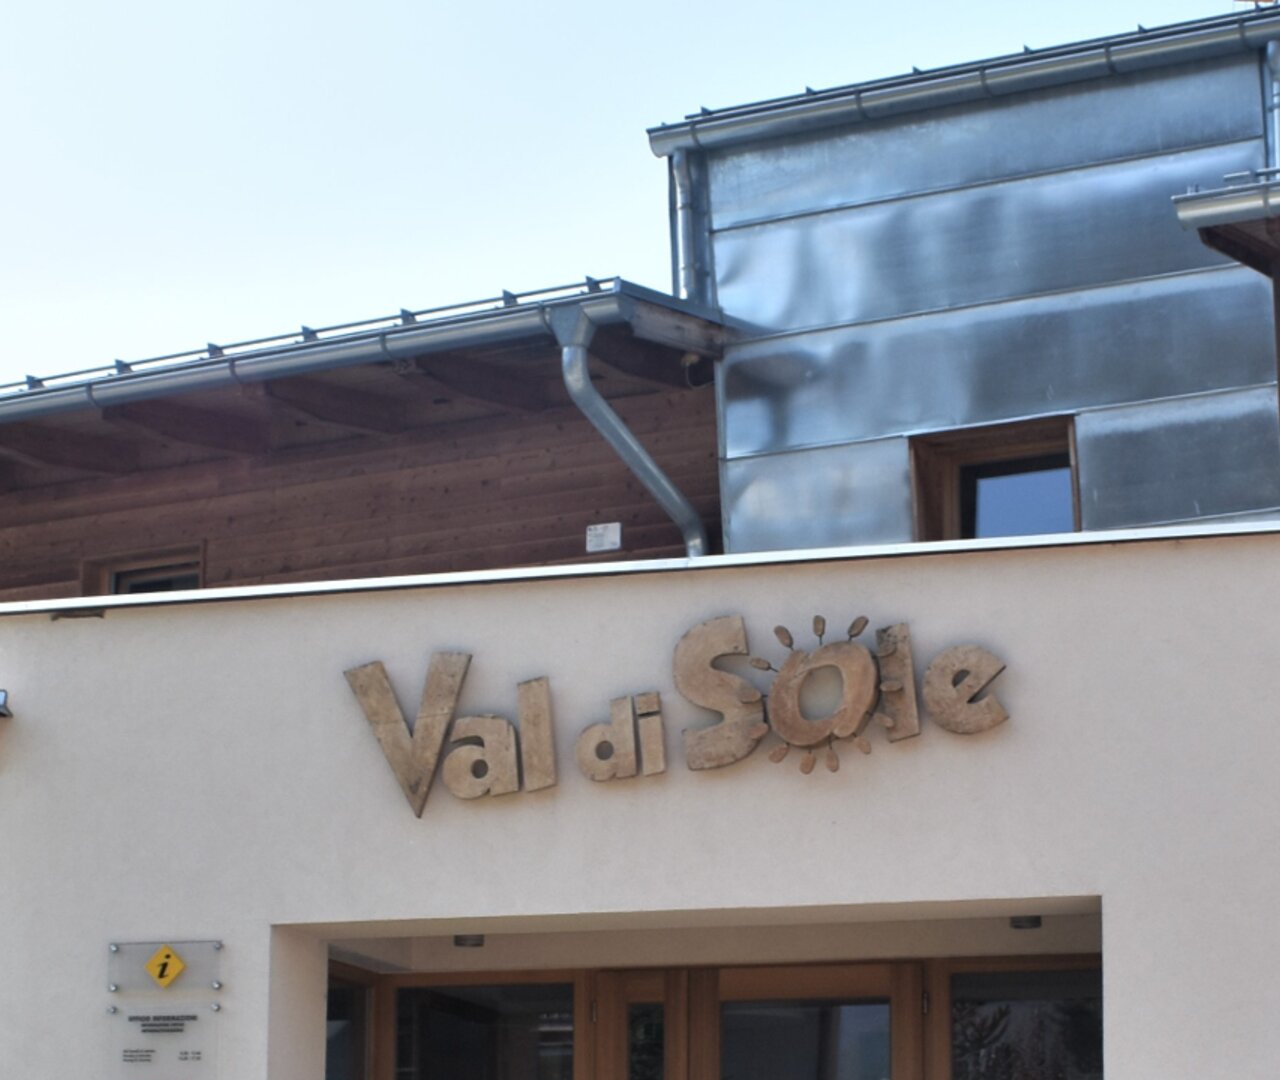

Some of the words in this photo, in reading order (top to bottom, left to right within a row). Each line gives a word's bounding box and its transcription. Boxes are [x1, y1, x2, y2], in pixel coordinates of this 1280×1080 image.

[343, 651, 557, 819] Val
[576, 691, 666, 782] di
[672, 614, 1010, 774] Sole
